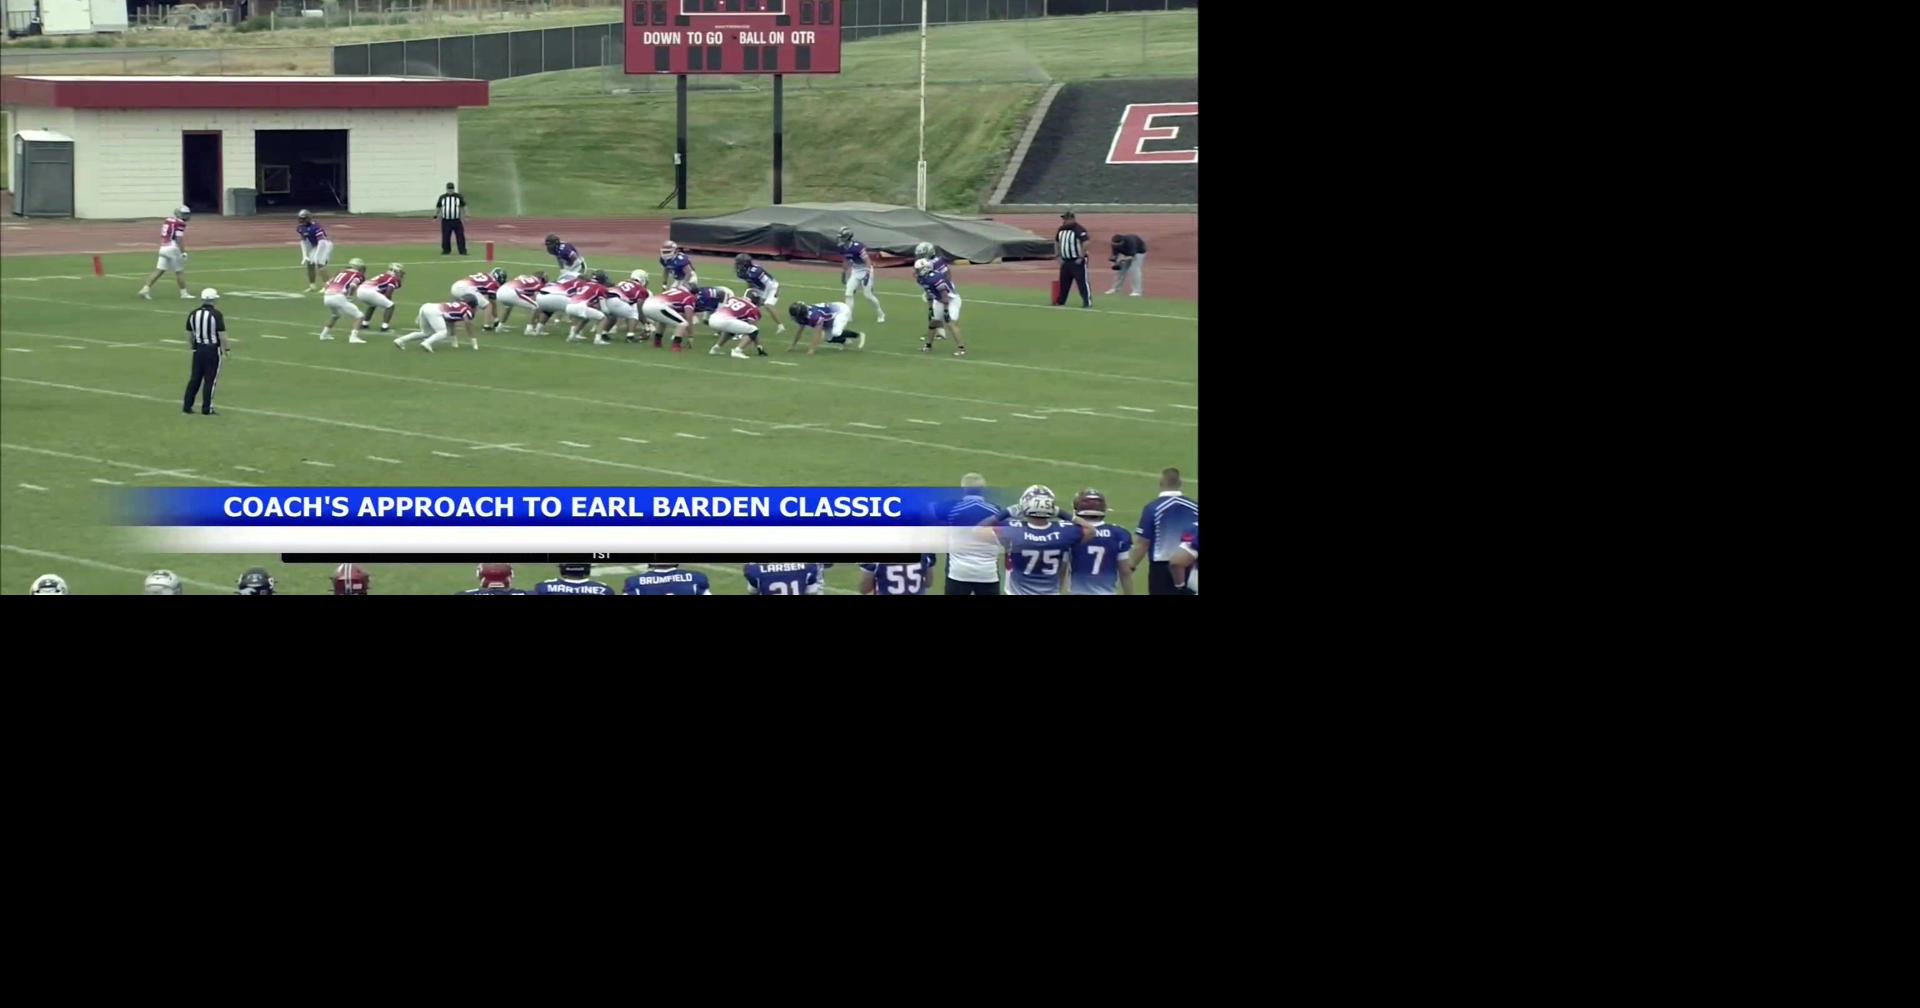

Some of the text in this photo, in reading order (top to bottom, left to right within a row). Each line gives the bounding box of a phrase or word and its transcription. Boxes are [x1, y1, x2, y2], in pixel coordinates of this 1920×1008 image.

[643, 31, 816, 45] DOWN TO GO BALL ON QTR
[1021, 549, 1061, 575] 75
[1087, 545, 1105, 575] 7
[760, 562, 806, 574] LARSEN
[639, 573, 693, 586] BRUMFIELD
[886, 563, 923, 595] 55
[547, 583, 606, 596] MARTINEZ
